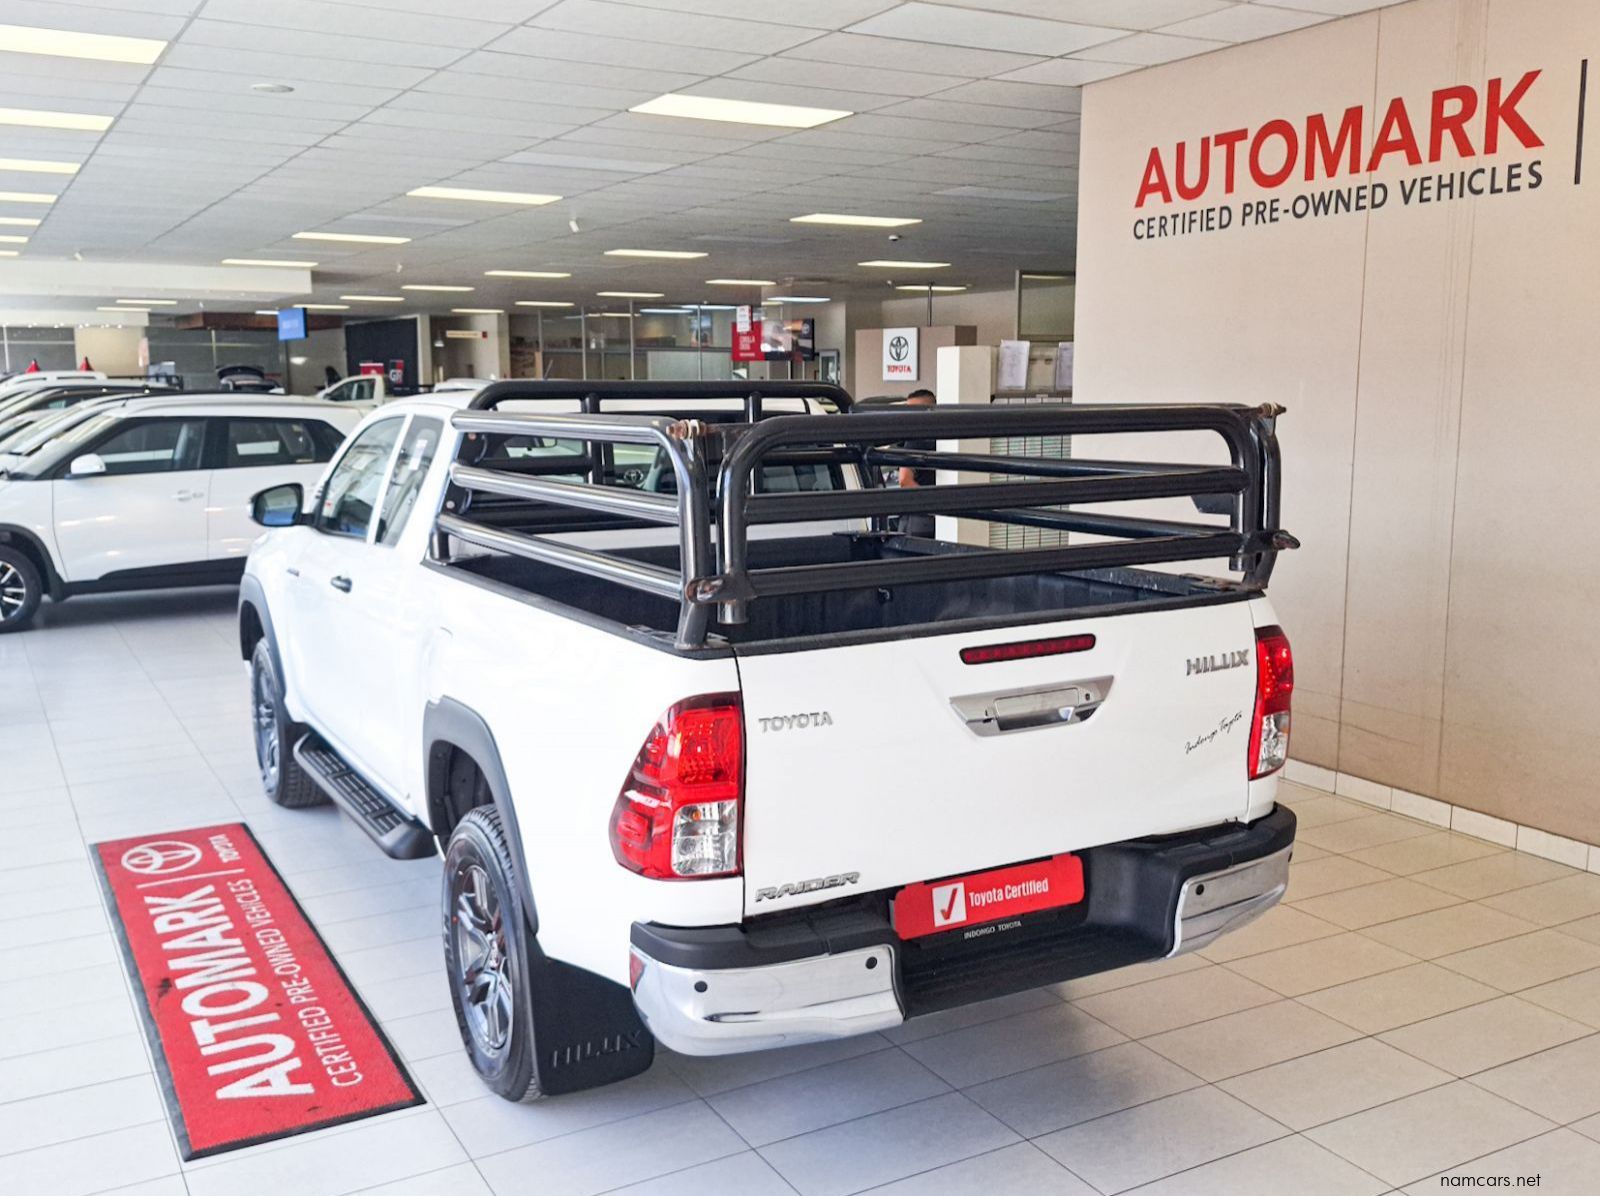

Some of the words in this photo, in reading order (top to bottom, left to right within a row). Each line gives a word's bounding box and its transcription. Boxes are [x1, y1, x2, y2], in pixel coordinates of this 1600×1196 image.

[1134, 69, 1545, 208] AUTOMARK
[1133, 205, 1232, 240] CERTIFIED
[1241, 182, 1388, 226] PRE-OWNED
[1399, 160, 1543, 205] VEHICLES
[887, 365, 912, 373] TOYOTA
[1186, 649, 1249, 676] HILUX
[758, 711, 833, 733] TOYOTA
[227, 878, 275, 928] VEHICLES
[755, 871, 860, 902] RAIDER
[969, 886, 1002, 907] Toyota
[1005, 878, 1049, 902] Certified
[964, 926, 996, 939] INDONGO
[998, 920, 1022, 931] TOYOTA
[256, 928, 318, 1005] PRE-OWNED
[144, 884, 315, 1099] AUTOMARK
[298, 1007, 363, 1087] CERTIFIED
